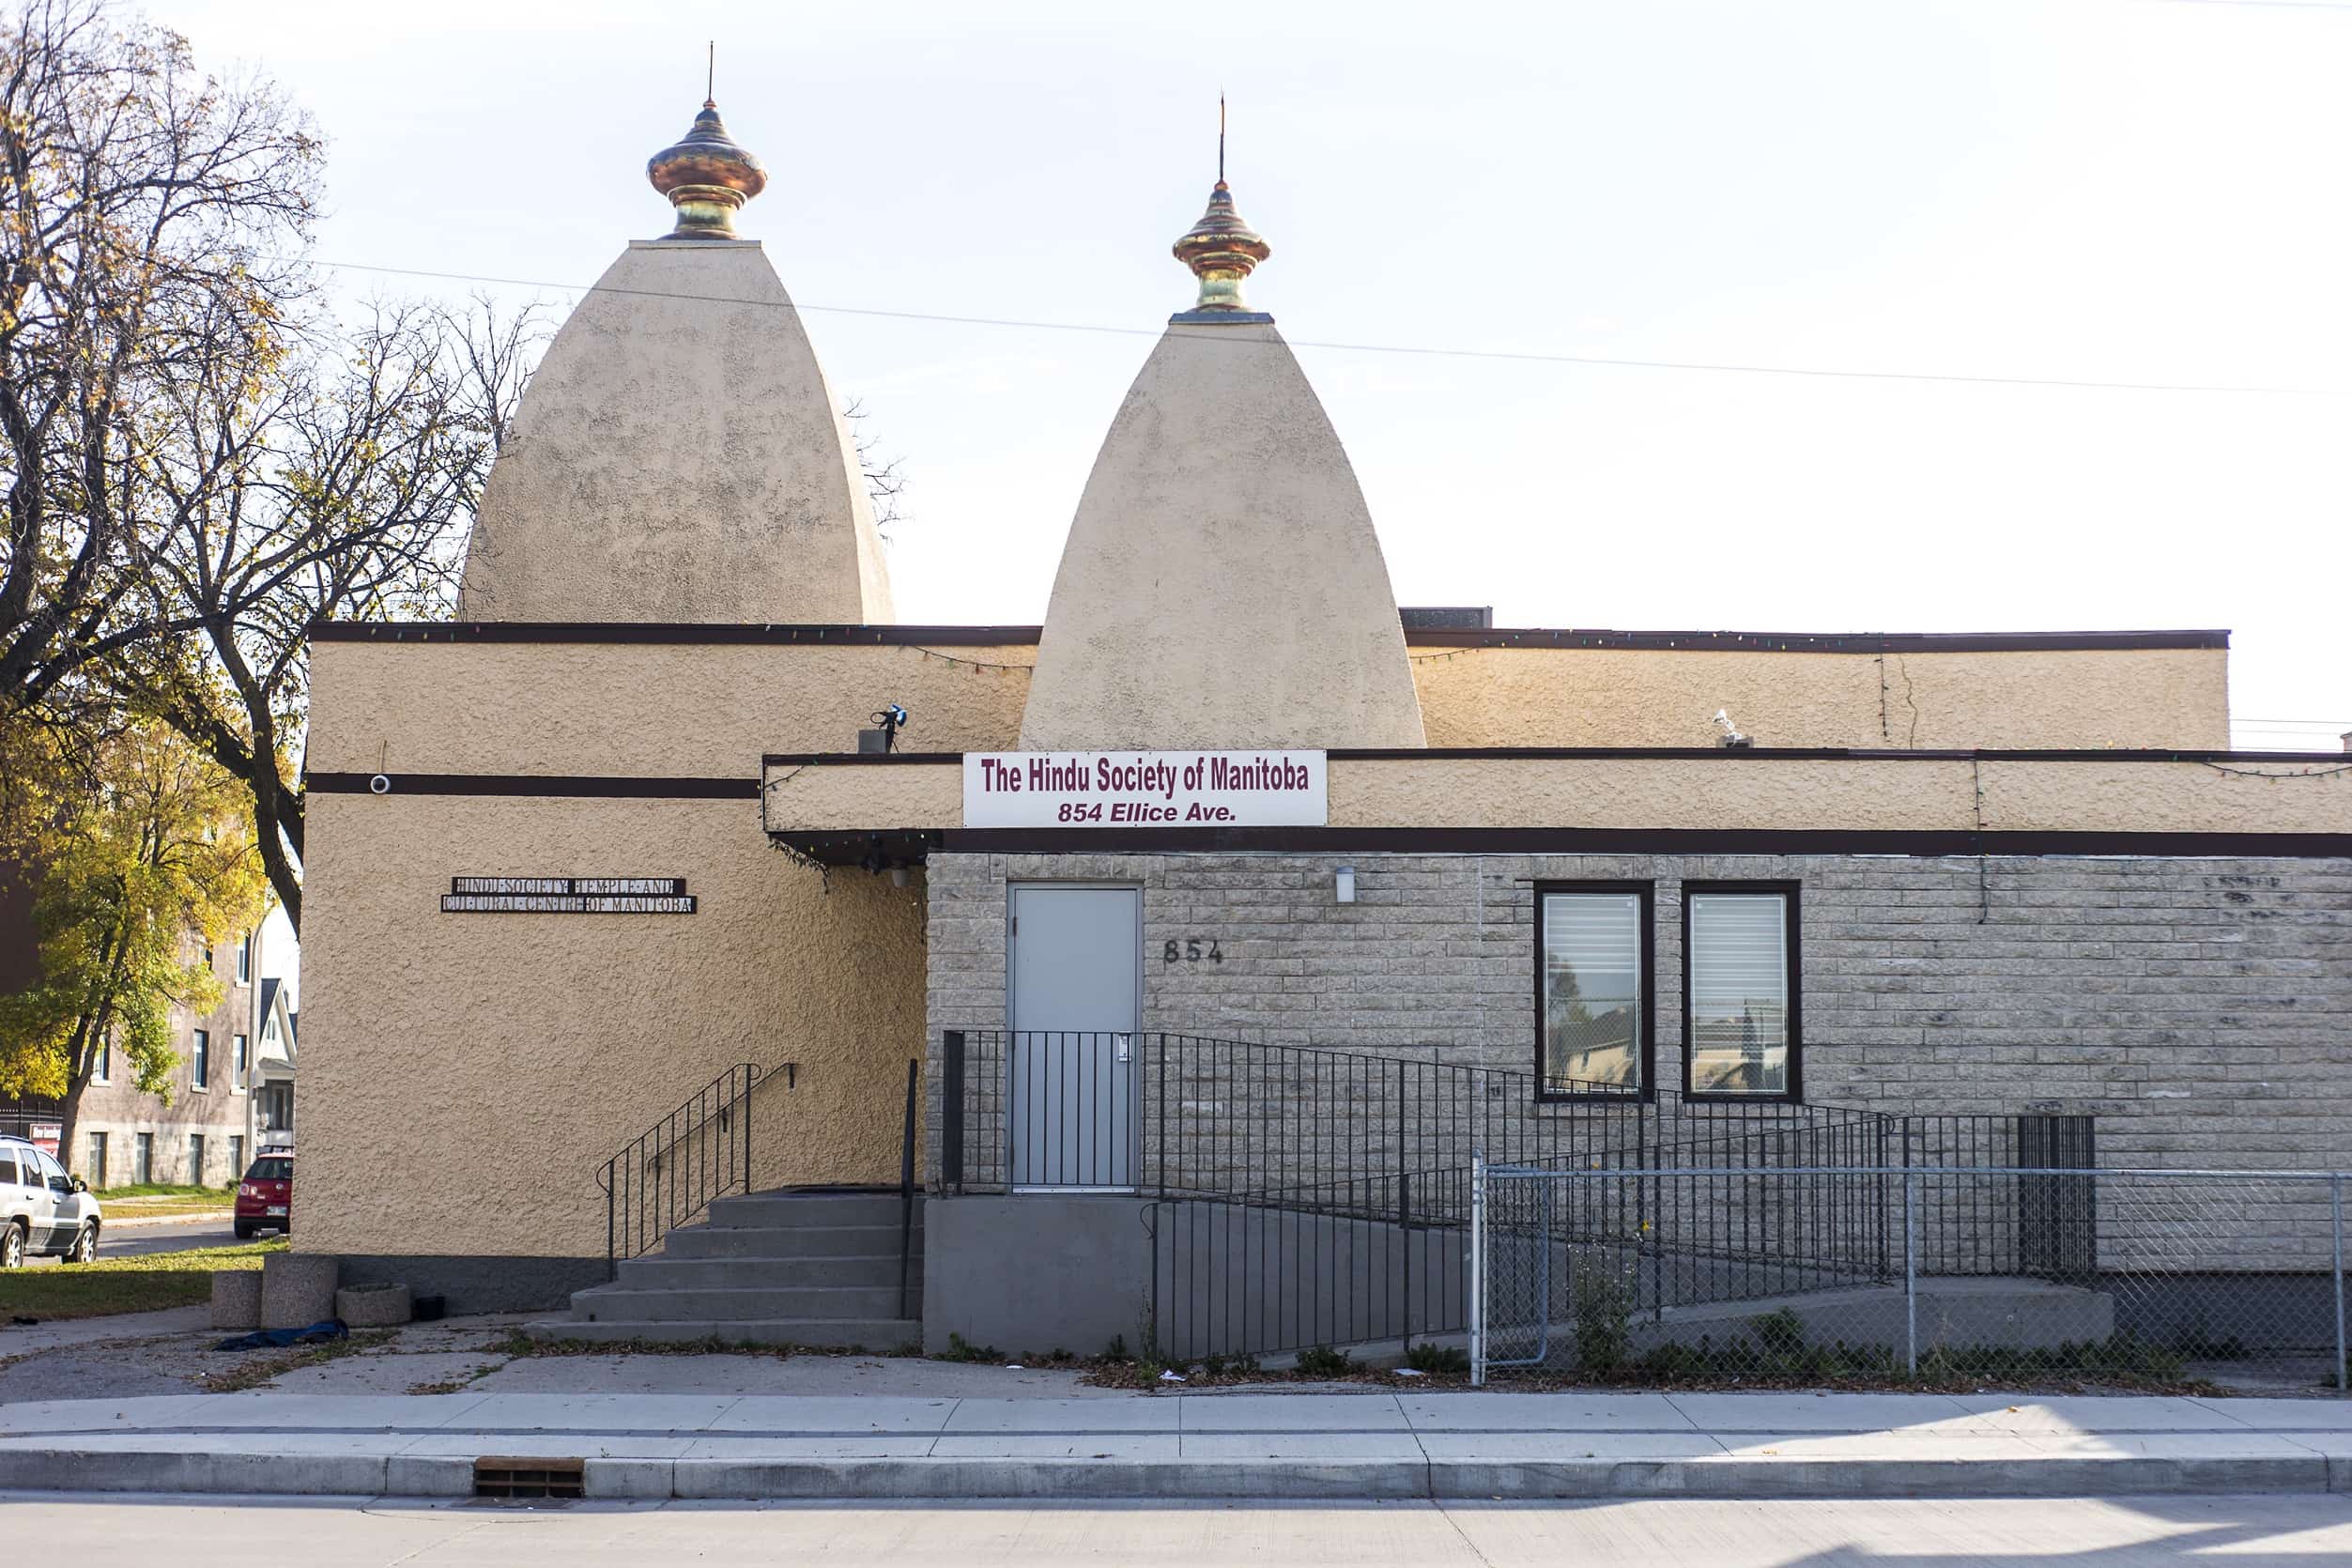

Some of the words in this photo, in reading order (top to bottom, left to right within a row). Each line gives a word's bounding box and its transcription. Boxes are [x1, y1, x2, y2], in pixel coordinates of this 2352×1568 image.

[981, 758, 1022, 792] The
[1029, 758, 1090, 792] Hindu
[1097, 757, 1177, 800] Society
[1183, 757, 1205, 792] of
[1210, 757, 1309, 792] Manitoba
[1057, 803, 1102, 822] 854
[1110, 803, 1178, 822] Ellice
[1185, 802, 1237, 822] Ave.
[457, 878, 499, 893] HINDU
[505, 879, 567, 893] SOCIETY
[576, 879, 635, 894] TEMPLE
[642, 879, 674, 894] AND
[444, 896, 515, 911] CULTURAL
[526, 896, 581, 911] CENTRE
[587, 897, 606, 912] OF
[612, 897, 692, 912] MANITOBA
[1164, 939, 1223, 963] 854
